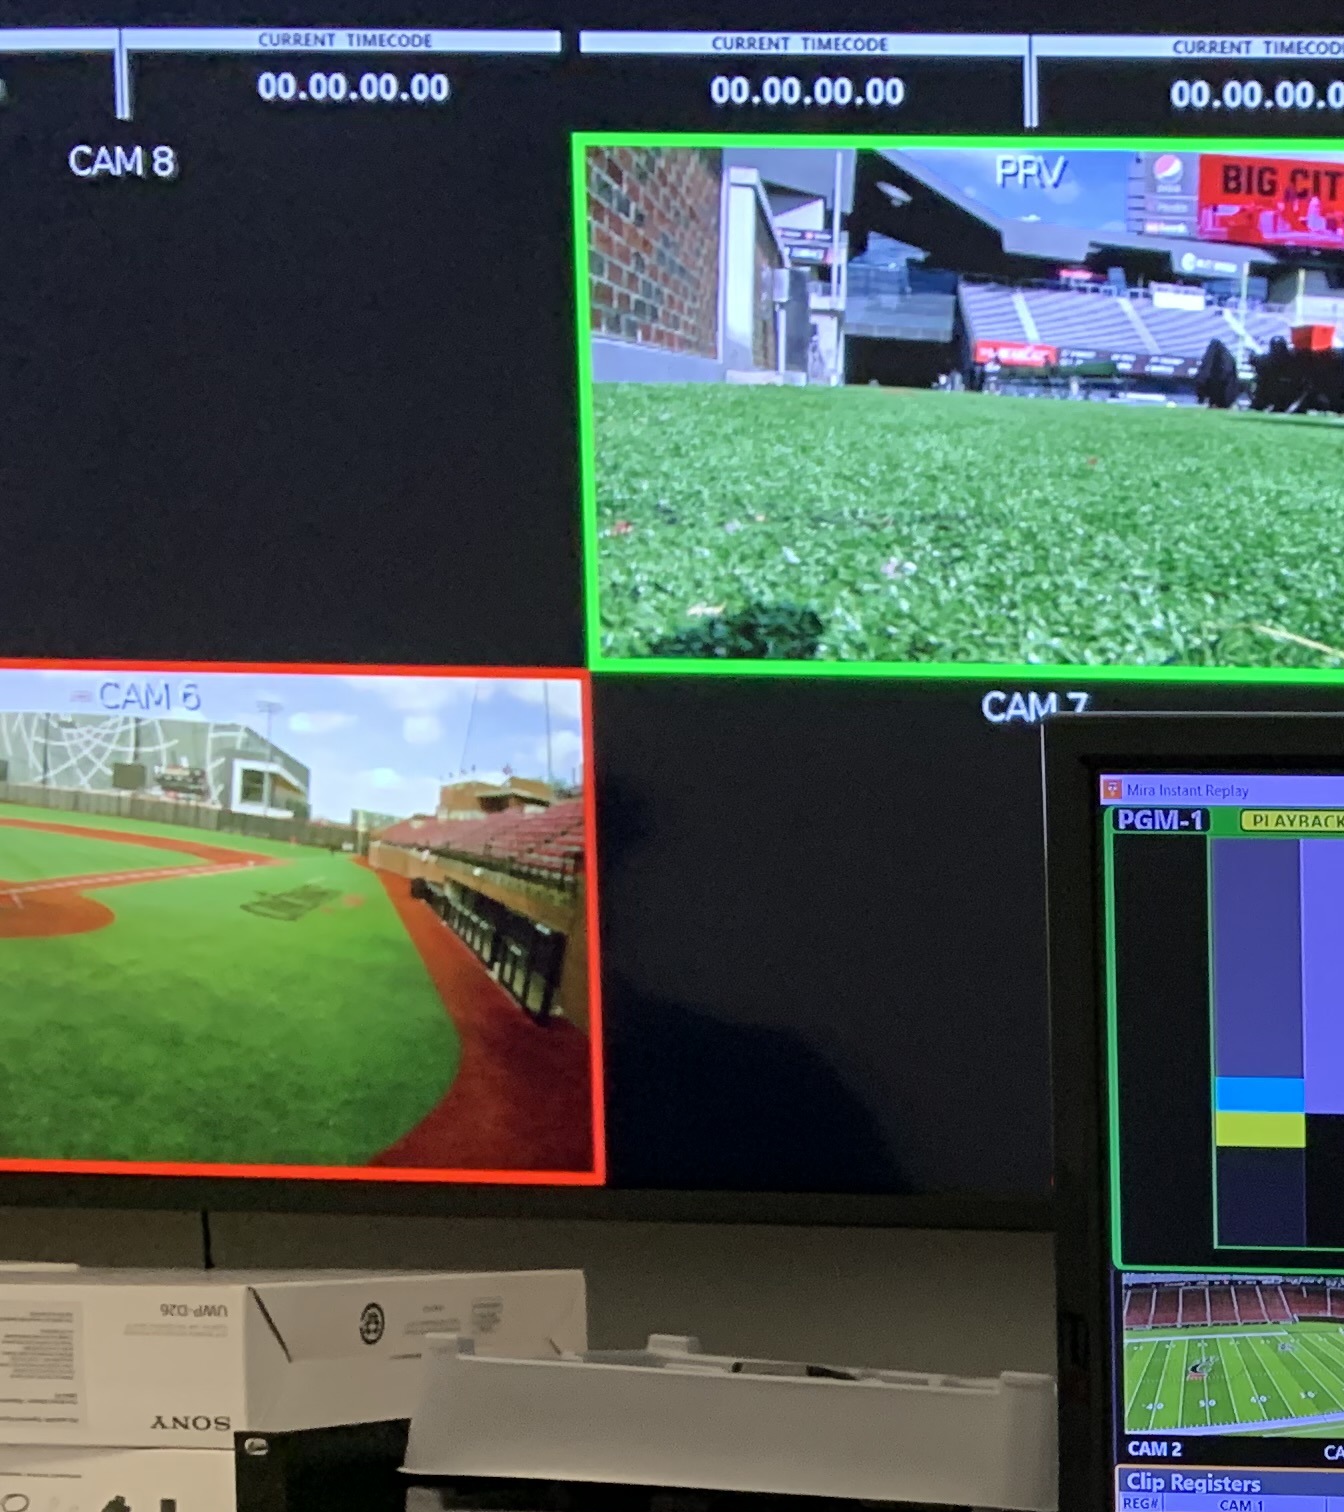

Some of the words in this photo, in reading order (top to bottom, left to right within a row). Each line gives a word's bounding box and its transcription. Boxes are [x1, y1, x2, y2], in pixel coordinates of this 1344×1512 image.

[258, 32, 337, 49] CURRENT
[346, 33, 433, 49] TIMECODE
[712, 35, 790, 53] CURRENT
[800, 36, 889, 53] TIMECODE
[1173, 39, 1253, 56] CURRENT
[257, 71, 449, 103] 00.00.00.00
[711, 75, 904, 107] 00.00.00.00
[68, 146, 145, 177] CAM
[152, 146, 176, 177] 8
[996, 155, 1069, 191] PRV
[1222, 164, 1277, 196] BIG
[100, 681, 174, 713] CAM
[182, 681, 202, 712] 6
[982, 692, 1057, 724] CAM
[1127, 783, 1155, 796] Mira
[1159, 784, 1202, 797] Instant
[1206, 784, 1249, 799] Replay
[1118, 811, 1204, 830] PGM-1
[151, 1416, 231, 1431] SONY
[1128, 1441, 1166, 1457] CAM
[1171, 1442, 1182, 1457] 2
[1127, 1474, 1167, 1494] Clip
[1171, 1475, 1261, 1495] Registers
